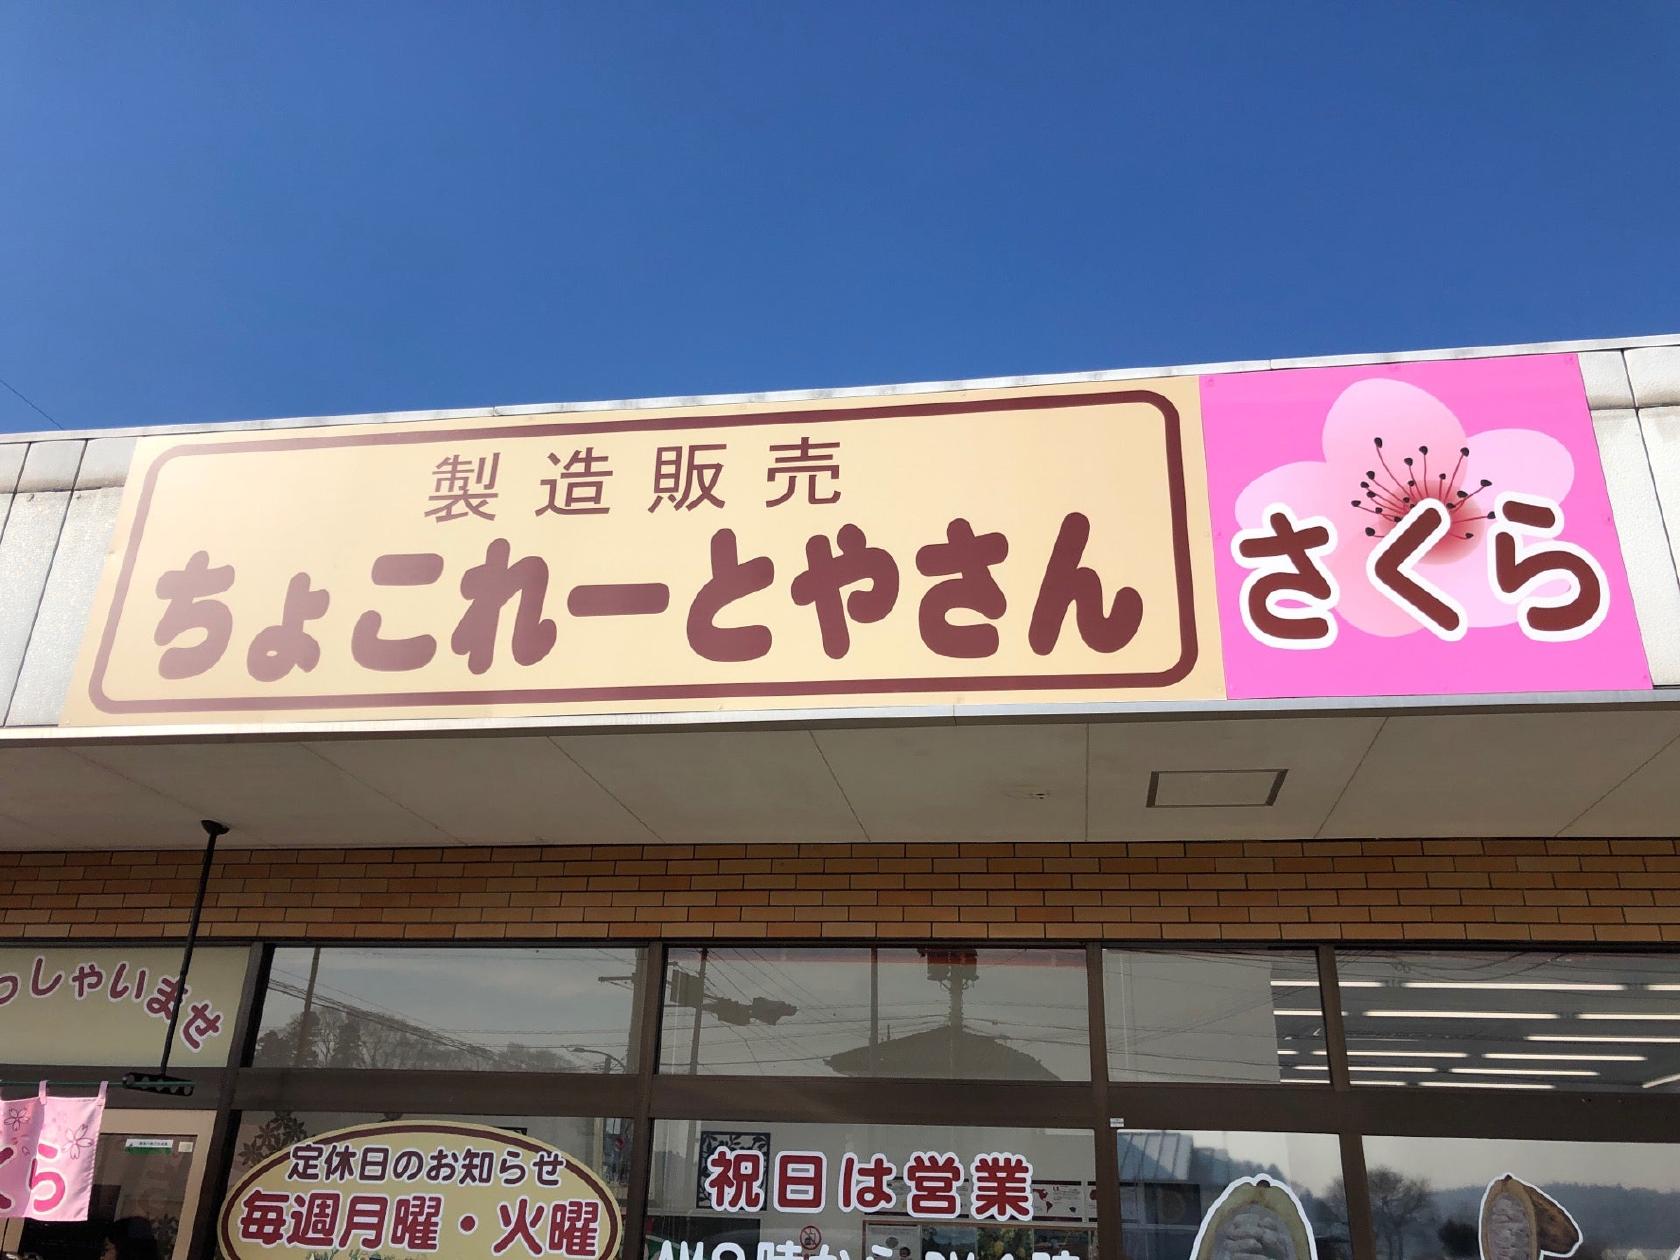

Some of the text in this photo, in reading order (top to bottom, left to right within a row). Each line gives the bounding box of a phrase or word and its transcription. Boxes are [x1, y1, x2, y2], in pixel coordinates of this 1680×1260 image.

[424, 436, 842, 523] 製造販売
[154, 511, 1144, 683] ちょこれーとやさん
[1236, 497, 1604, 642] さくら
[287, 1144, 565, 1187] 定休日のお知らせ
[708, 1149, 1031, 1219] 祝日は営業
[239, 1189, 600, 1257] 毎週月曜・火曜
